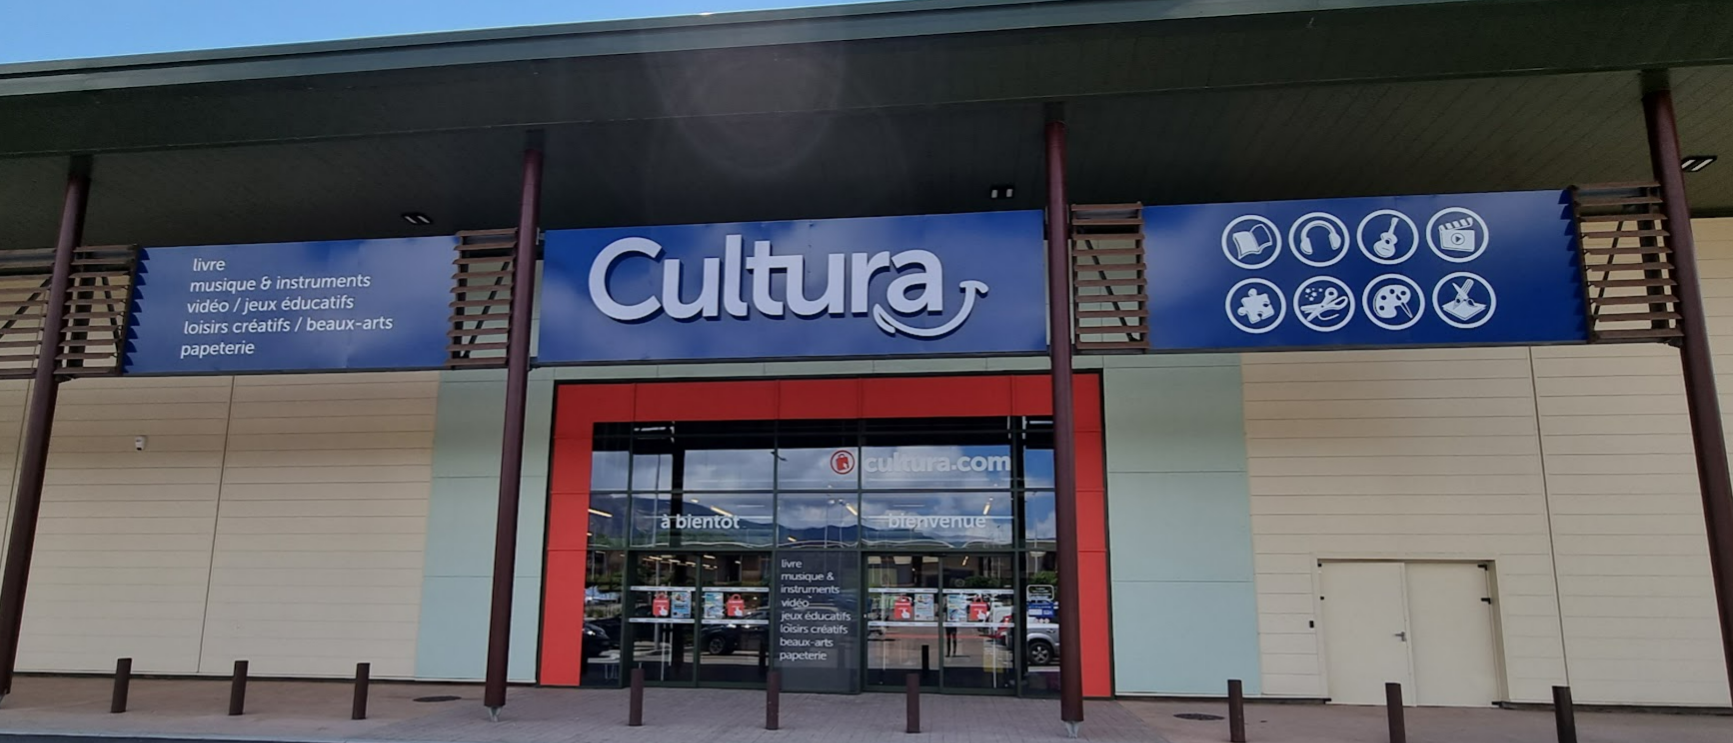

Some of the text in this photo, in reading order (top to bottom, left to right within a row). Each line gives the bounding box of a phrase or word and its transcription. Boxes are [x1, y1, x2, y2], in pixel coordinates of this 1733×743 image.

[192, 258, 226, 272] livre
[190, 274, 371, 294] musique & instruments
[588, 234, 943, 320] Cultura
[187, 298, 230, 313] vidéo
[242, 298, 278, 315] jeux
[281, 295, 354, 311] éducatifs
[183, 319, 229, 335] loisirs
[232, 316, 291, 333] créatifs
[306, 315, 394, 331] beaux-arts
[180, 340, 255, 359] papeterie
[864, 452, 1011, 472] cultura.com
[660, 513, 671, 529] à
[887, 512, 988, 529] bienvenue
[781, 559, 802, 568] livre
[780, 572, 834, 582] musique &
[780, 584, 840, 594] instruments
[780, 598, 810, 608] vidéo
[780, 611, 802, 622] jeux
[804, 611, 851, 621] éducatifs
[780, 624, 848, 634] loisirs créatifs
[780, 637, 834, 648] beaux-arts
[780, 651, 827, 661] papeterie
